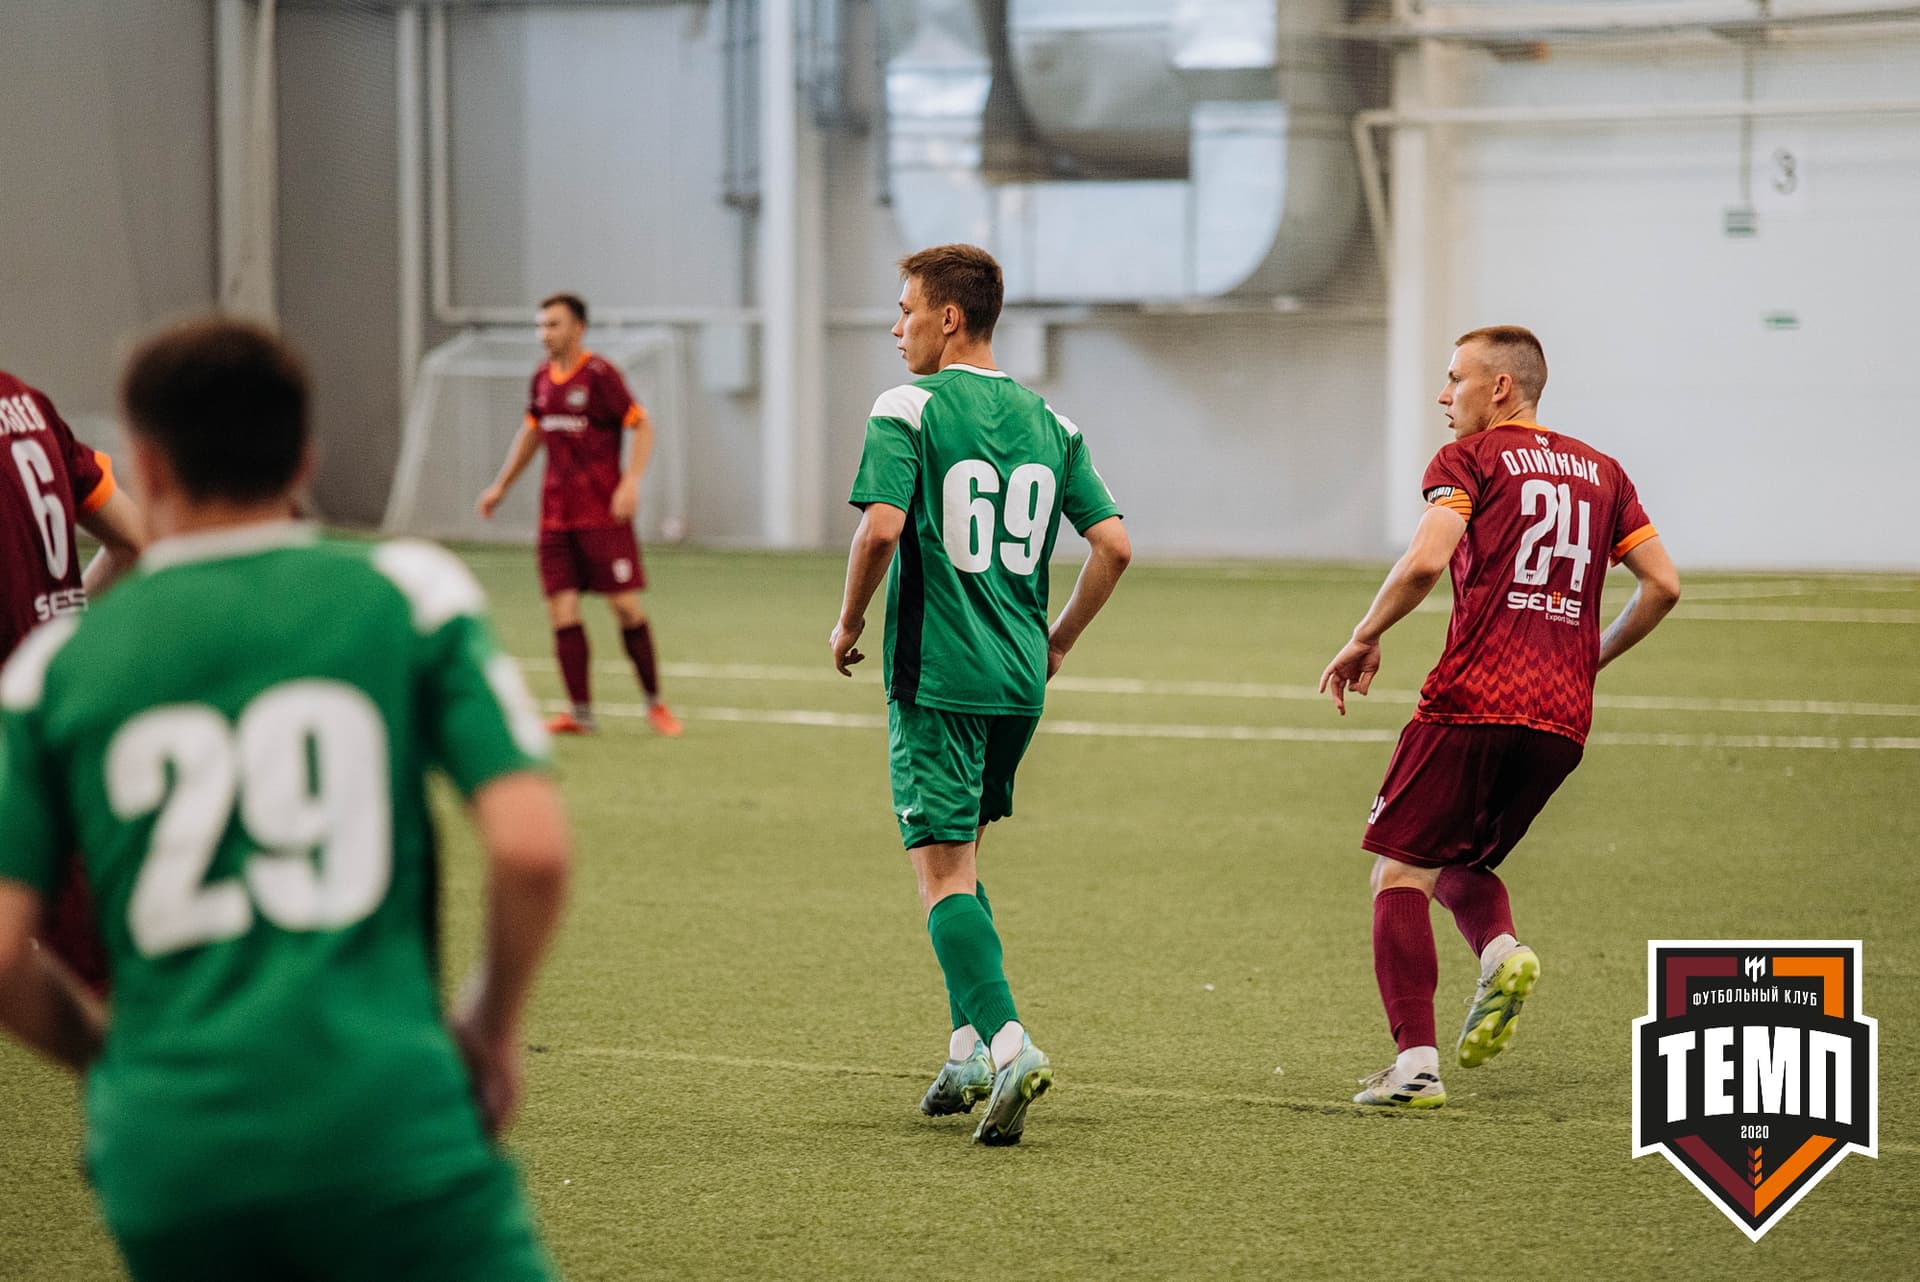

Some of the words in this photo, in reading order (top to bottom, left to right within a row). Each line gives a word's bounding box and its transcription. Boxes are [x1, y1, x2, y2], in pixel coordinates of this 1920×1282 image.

[1772, 149, 1797, 195] 3
[11, 439, 69, 580] 6
[943, 459, 1056, 575] 69
[1501, 446, 1600, 486] ОЛИЙНЫК
[1513, 479, 1592, 592] 24
[105, 677, 393, 959] 29
